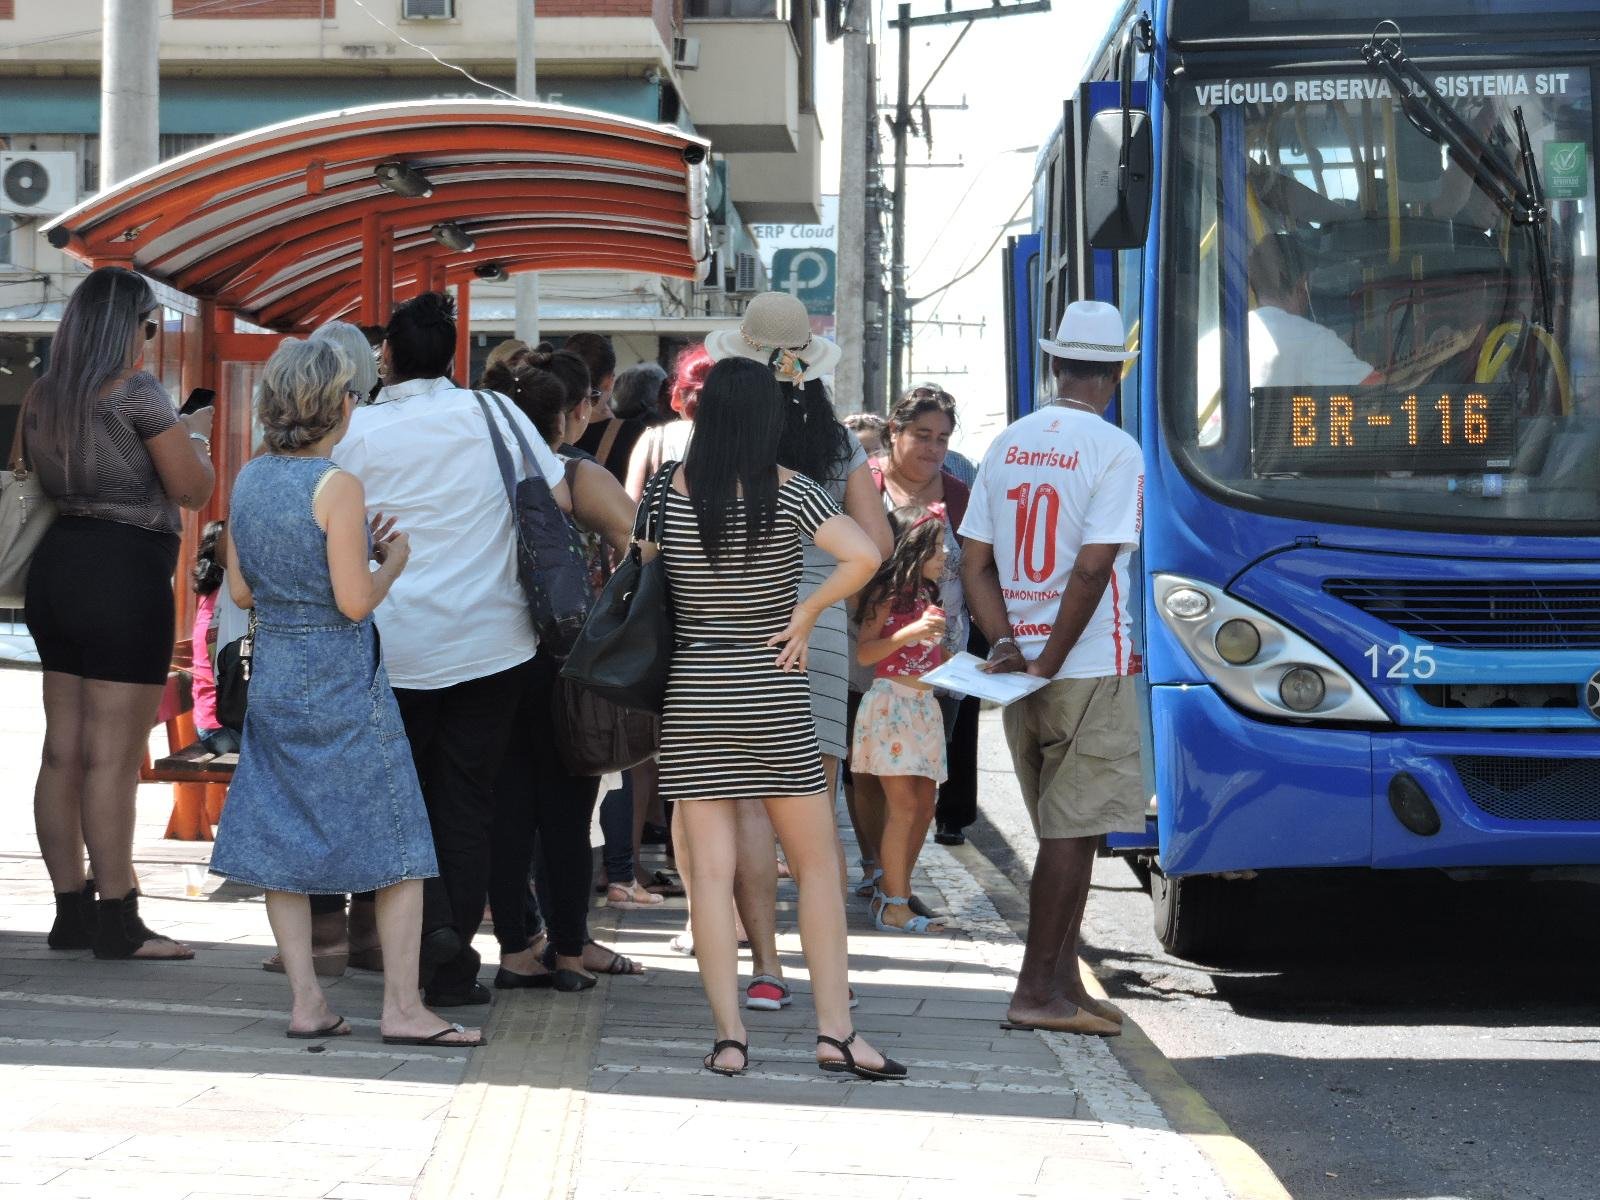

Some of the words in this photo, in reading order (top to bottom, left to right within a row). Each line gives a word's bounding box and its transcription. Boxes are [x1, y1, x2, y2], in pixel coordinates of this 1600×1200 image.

[1195, 79, 1288, 106] VEÍCULO
[1294, 78, 1392, 102] RESERVA
[1434, 73, 1529, 97] SISTEMA
[1535, 73, 1570, 95] SIT
[791, 223, 835, 239] Cloud
[1292, 393, 1488, 447] BR-116
[1004, 445, 1080, 472] Banrisul
[1006, 482, 1060, 584] 10
[1363, 643, 1436, 680] 125
